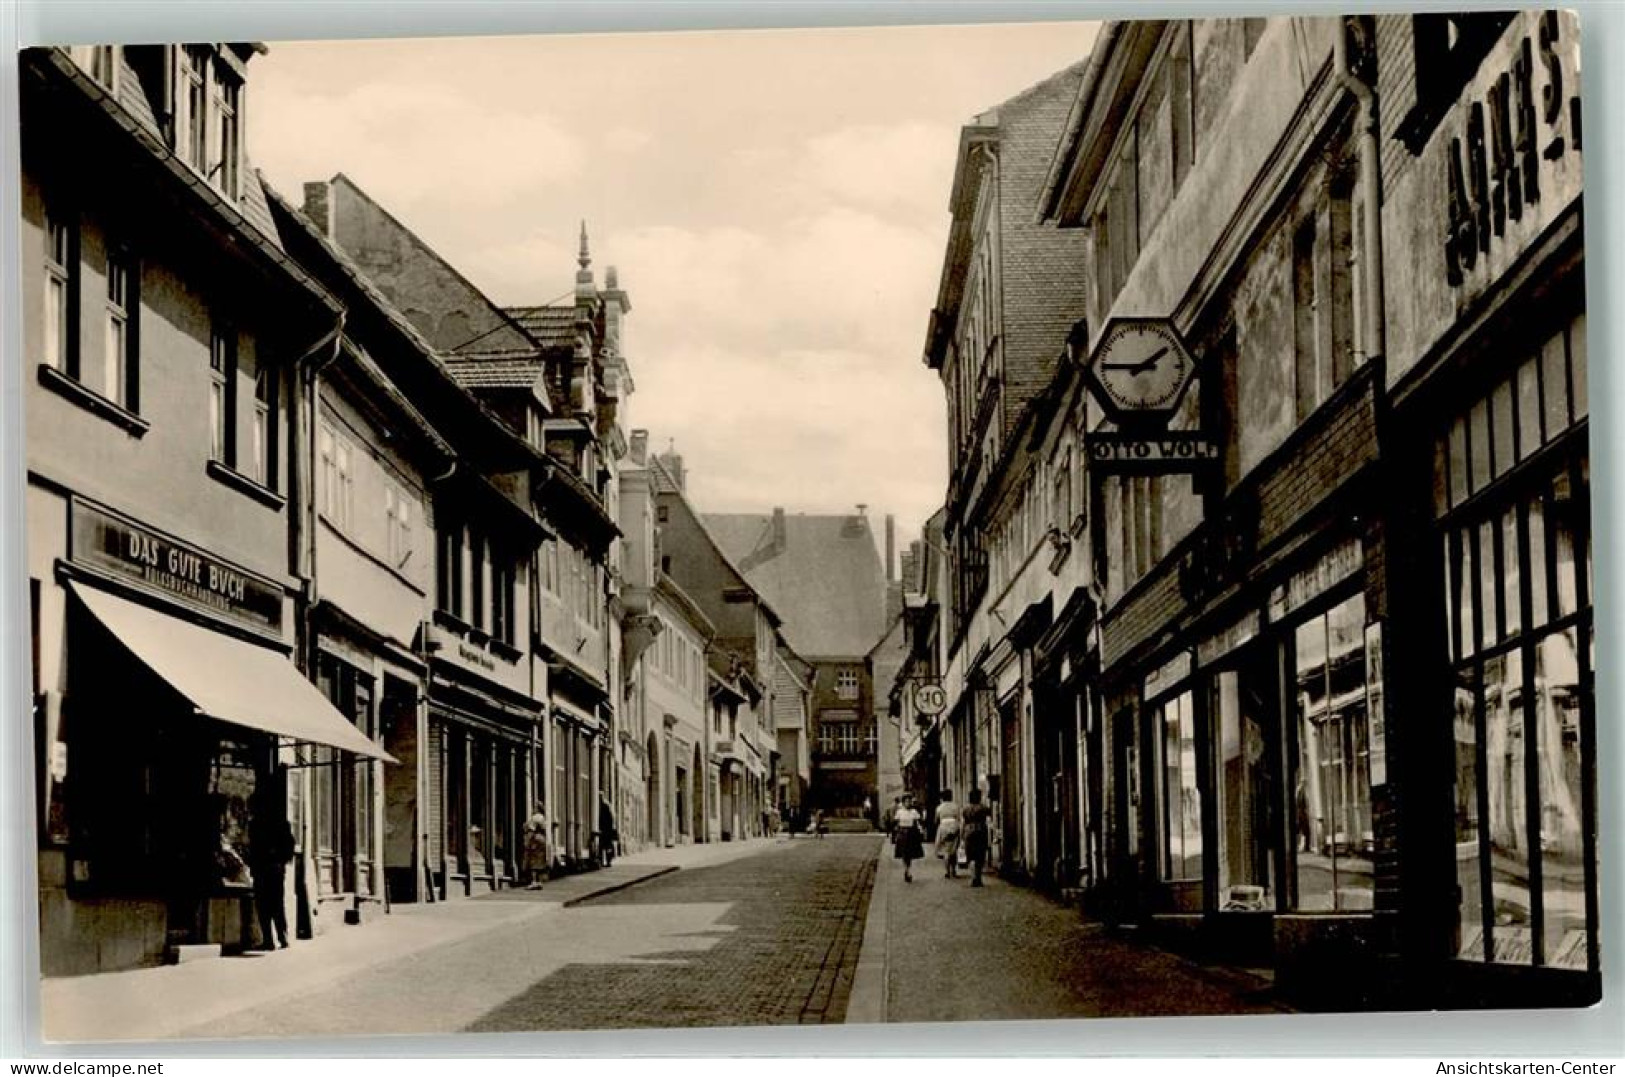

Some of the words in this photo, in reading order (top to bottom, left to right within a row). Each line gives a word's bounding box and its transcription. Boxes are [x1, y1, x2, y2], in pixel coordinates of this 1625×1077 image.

[1095, 441, 1152, 459] OTTO
[129, 530, 160, 567] DAS
[168, 547, 202, 584] GUTE
